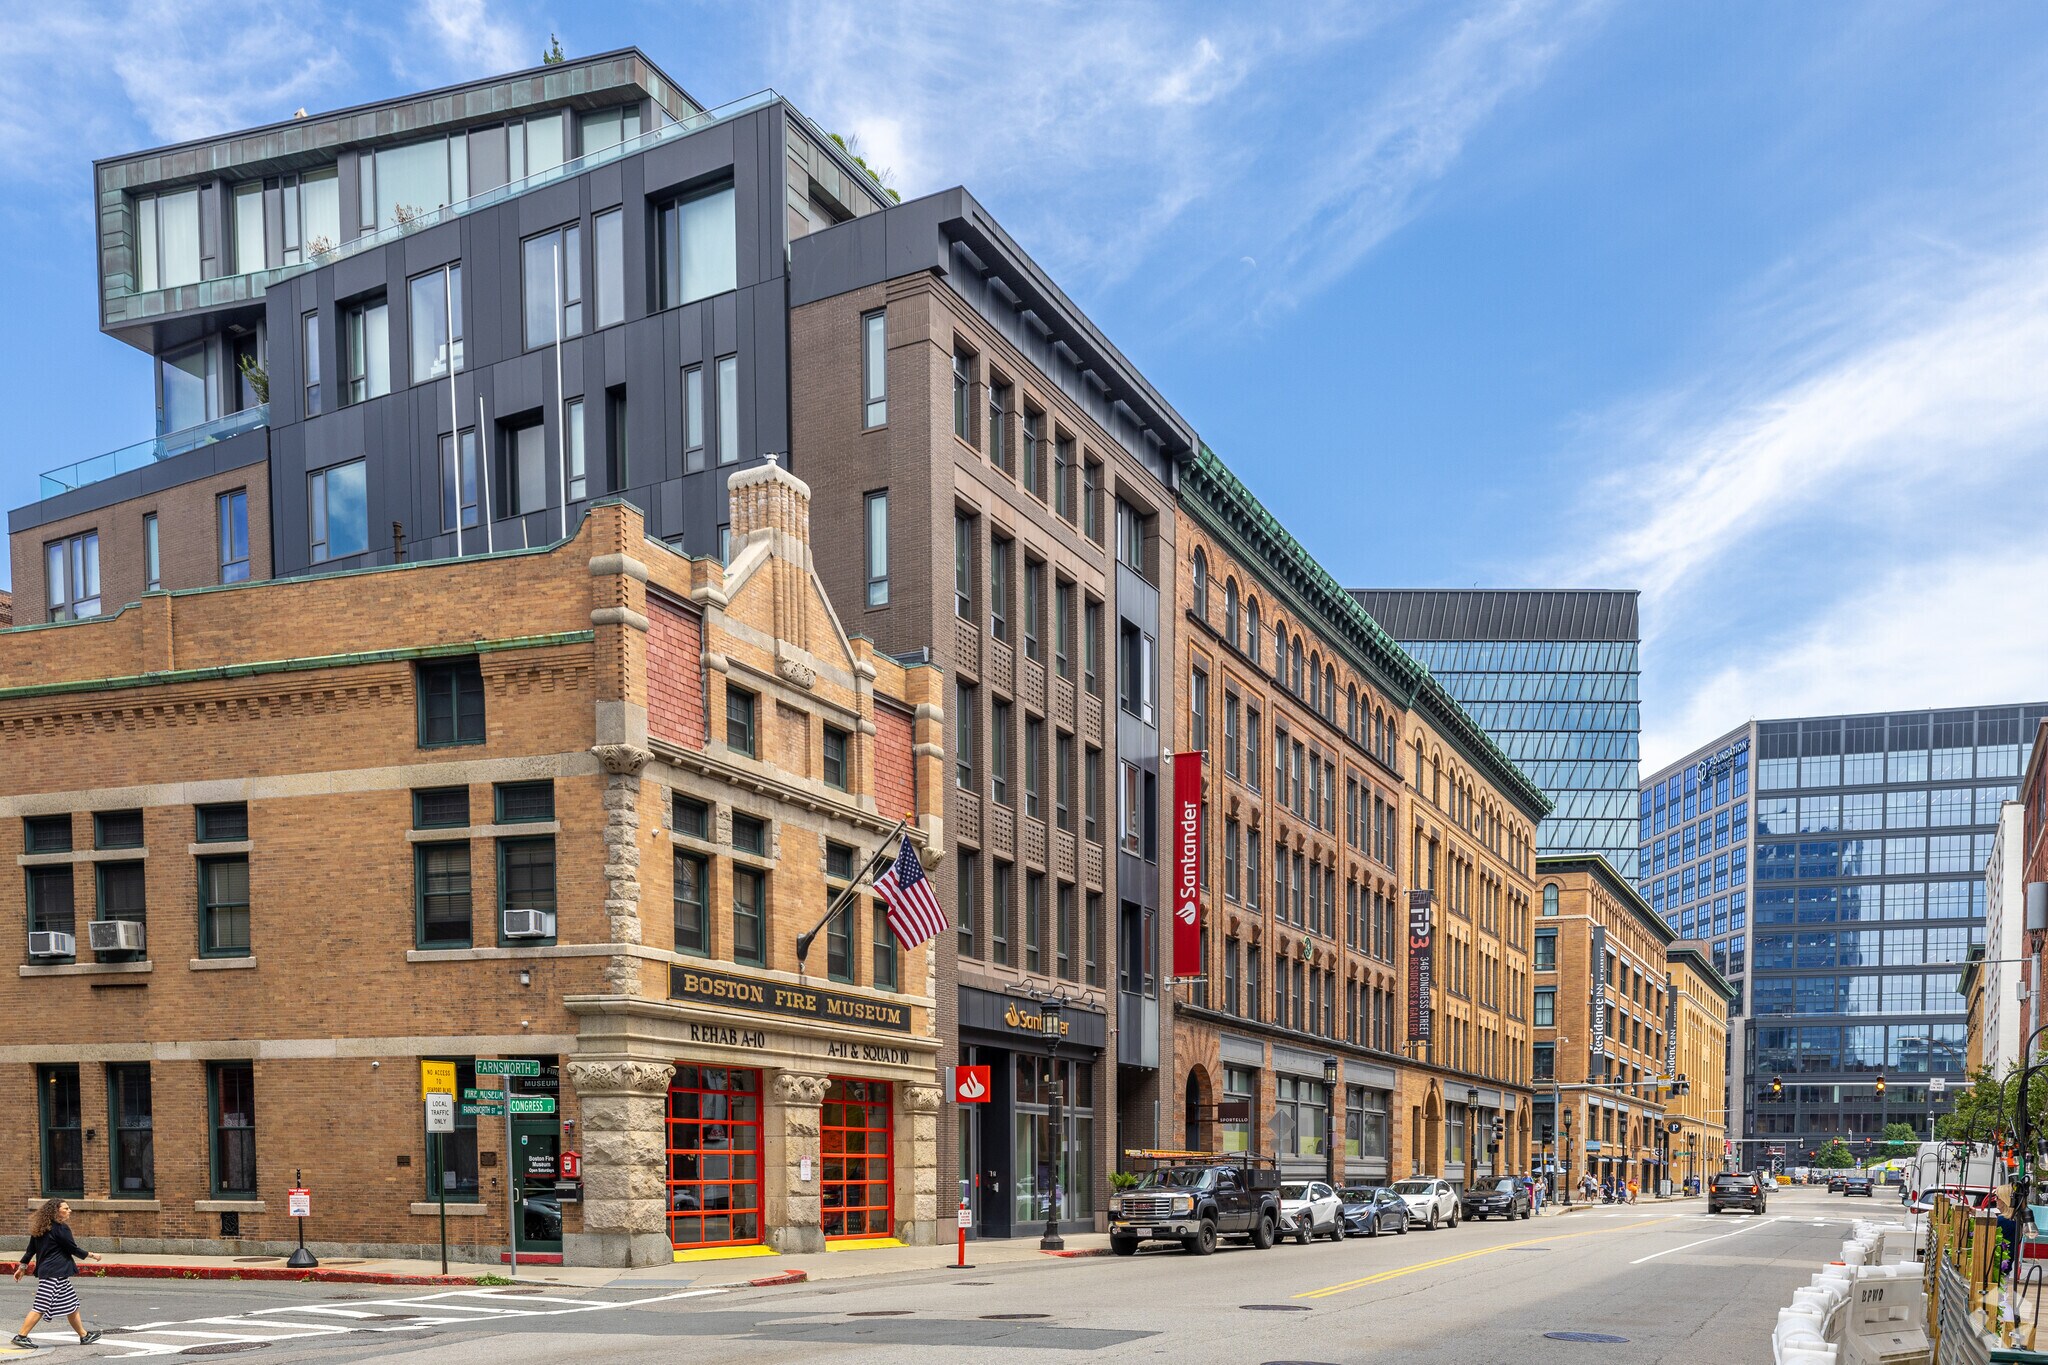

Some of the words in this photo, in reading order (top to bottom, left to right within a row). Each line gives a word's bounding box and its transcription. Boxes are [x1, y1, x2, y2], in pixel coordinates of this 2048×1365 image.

[1709, 740, 1748, 767] FOUNDATION
[1180, 801, 1196, 898] Santander
[1420, 956, 1430, 970] 346
[1410, 957, 1419, 998] RESIDENCES
[1420, 972, 1430, 1008] CONGRESS
[684, 973, 763, 1003] BOSTON
[775, 989, 816, 1011] FIRE
[827, 998, 901, 1024] MUSEUM
[1596, 984, 1604, 997] INN
[1020, 1010, 1070, 1036] Santer
[1409, 1007, 1418, 1036] GALLERY
[1420, 1010, 1429, 1036] STREET
[1593, 998, 1604, 1055] Residence
[691, 1024, 737, 1046] REHAB
[741, 1029, 765, 1049] A-10
[828, 1041, 848, 1059] A-11
[851, 1043, 859, 1059] &
[863, 1044, 898, 1064] SQUAD
[900, 1049, 909, 1065] 10
[477, 1062, 531, 1074] FARNSWORTH
[533, 1067, 539, 1075] ST
[432, 1100, 448, 1108] LOCAL
[464, 1090, 478, 1099] FIRE
[479, 1090, 504, 1099] MUSEUM
[511, 1100, 543, 1111] CONGRESS
[463, 1105, 490, 1114] FARNSWORTH
[1672, 1124, 1679, 1132] P
